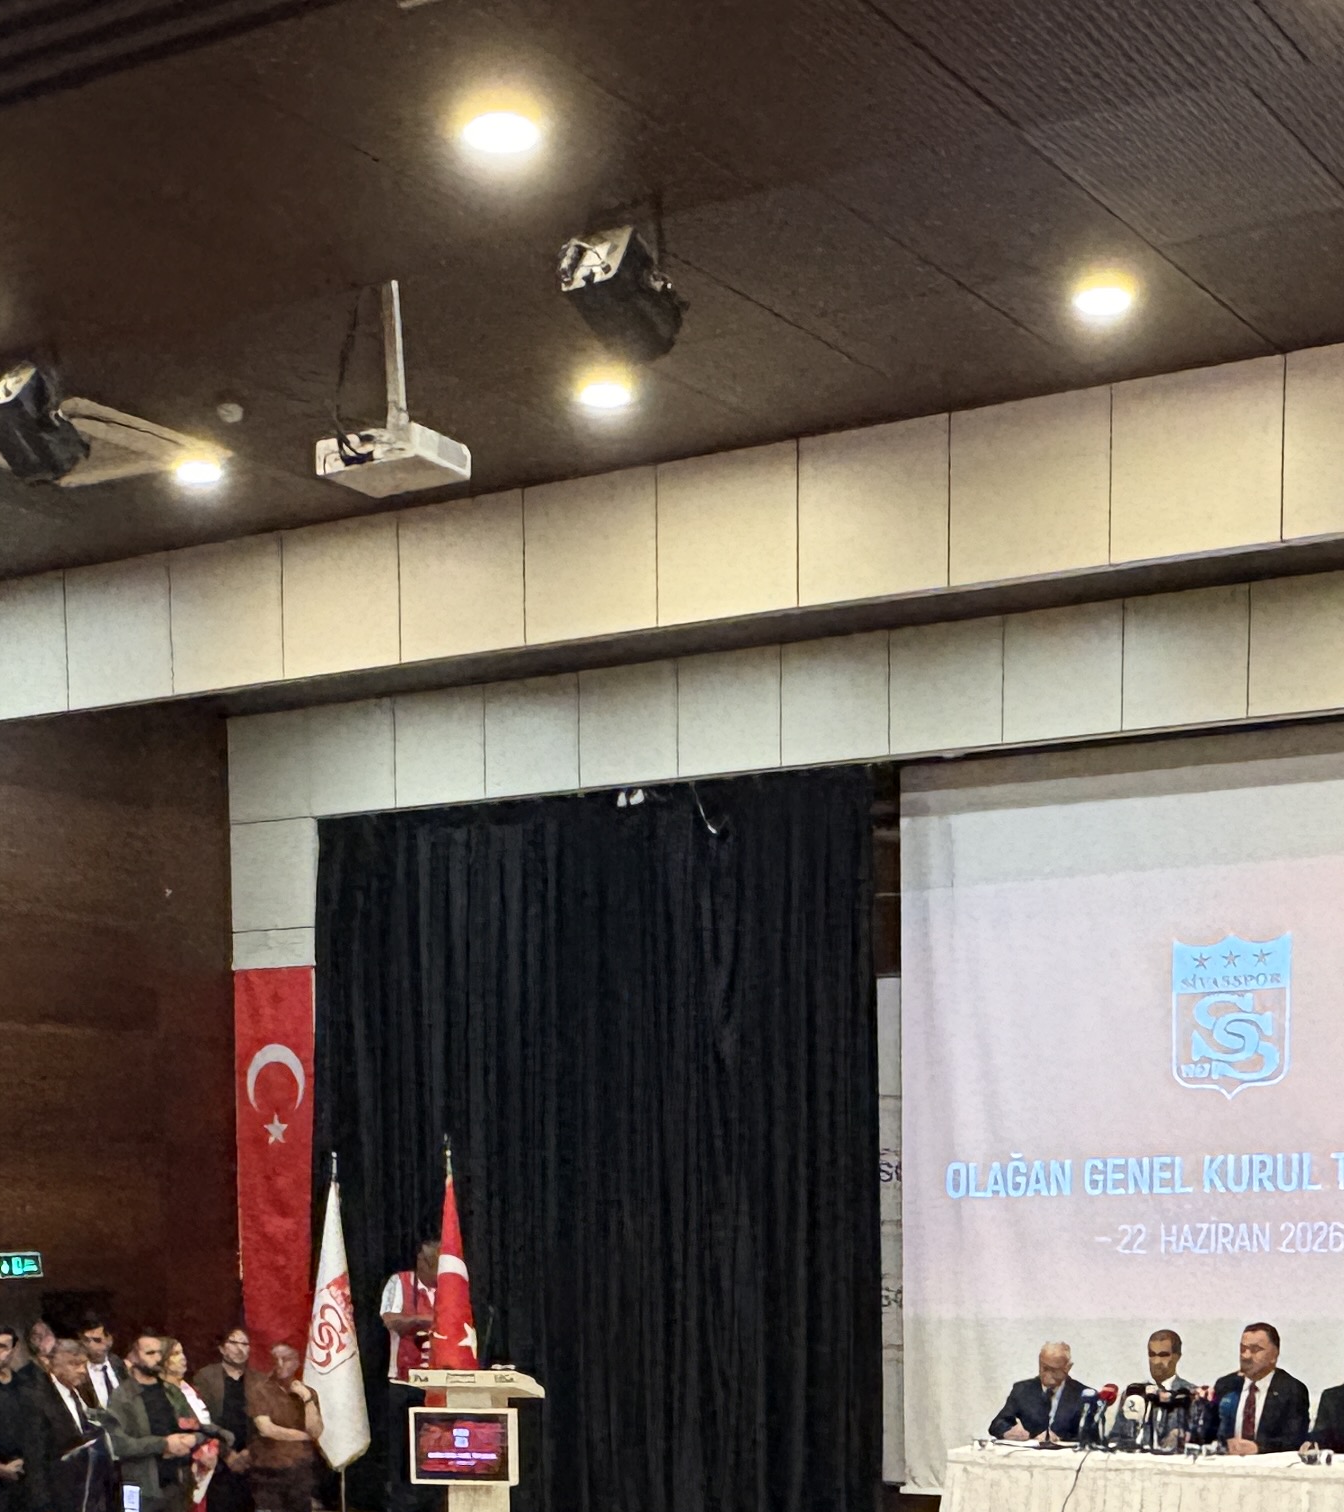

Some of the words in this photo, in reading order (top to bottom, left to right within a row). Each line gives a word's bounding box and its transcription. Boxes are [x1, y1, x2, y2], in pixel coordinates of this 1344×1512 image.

[946, 1152, 1072, 1198] OLAĞAN
[1083, 1156, 1193, 1196] GENEL
[1203, 1152, 1322, 1193] KURUL
[1160, 1217, 1270, 1254] HAZİRAN
